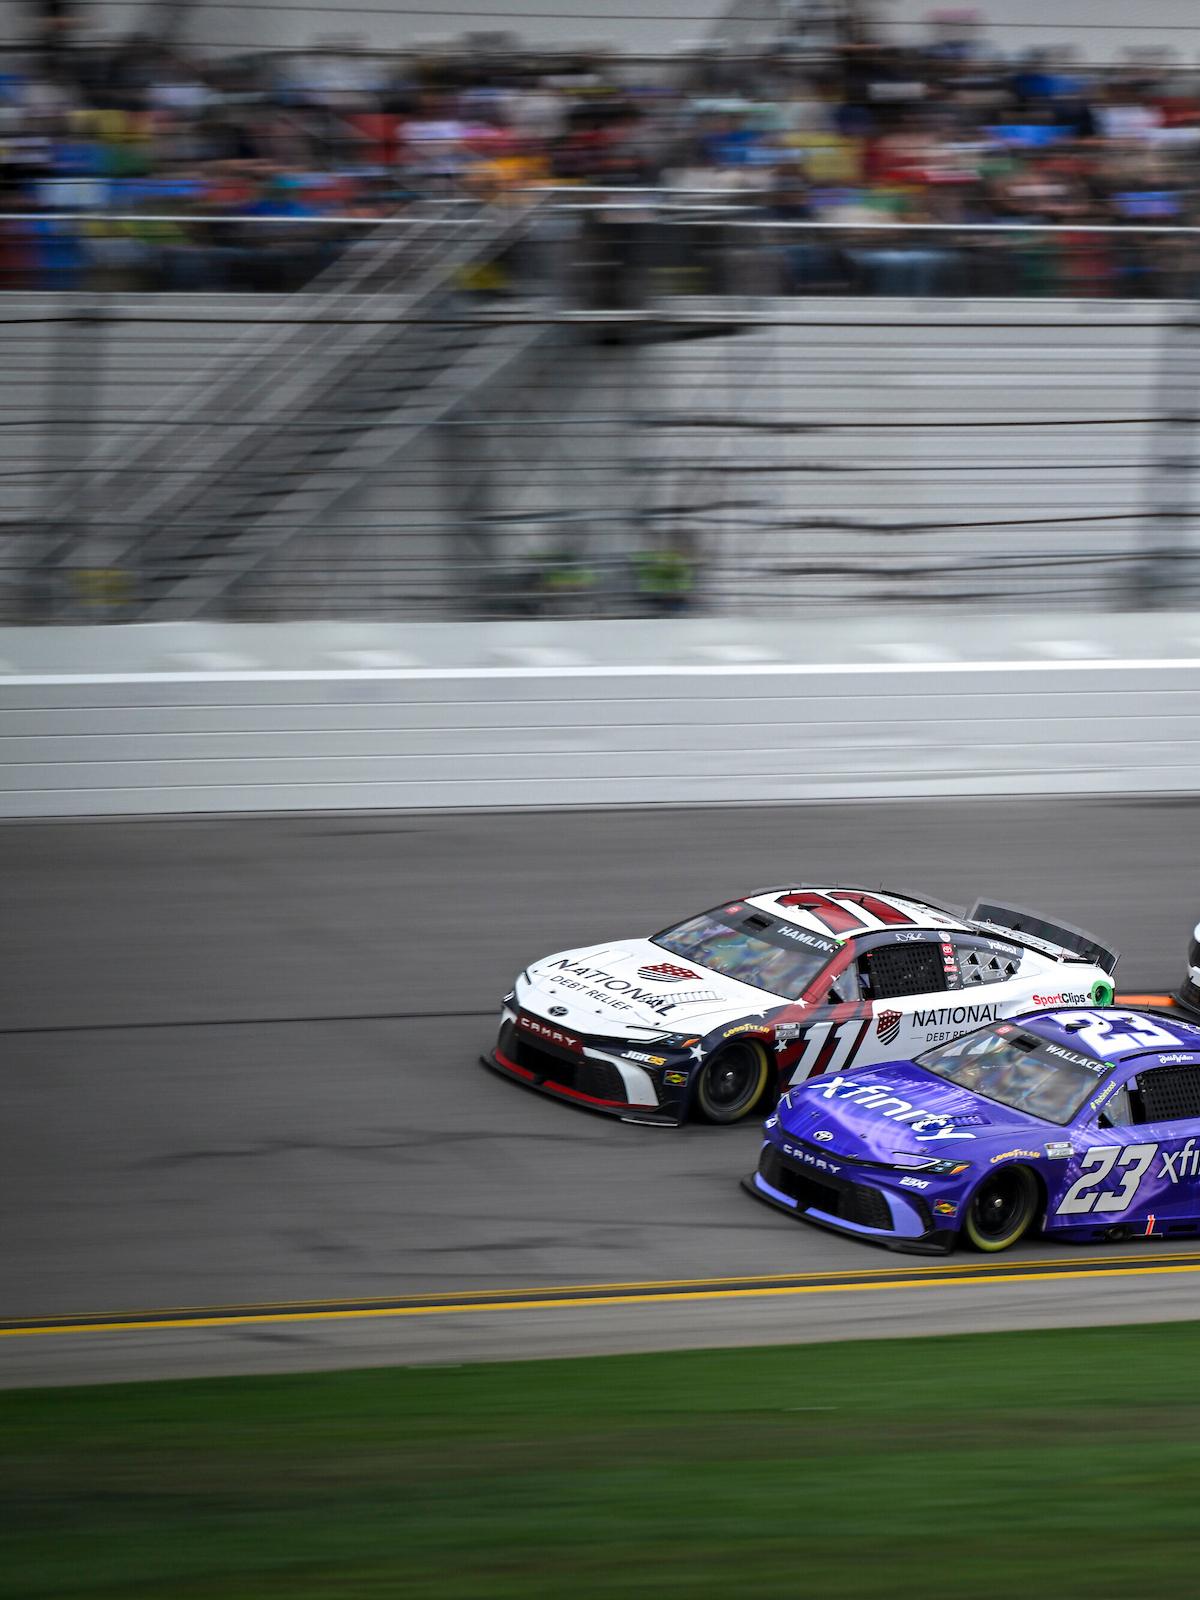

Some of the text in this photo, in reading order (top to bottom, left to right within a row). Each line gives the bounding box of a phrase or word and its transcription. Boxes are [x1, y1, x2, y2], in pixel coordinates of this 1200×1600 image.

[774, 892, 919, 935] 11
[778, 925, 833, 952] HAMLIN
[987, 940, 1017, 955] yahoo!
[547, 959, 677, 1017] NATIONAL
[550, 975, 633, 1011] DEBT RELIEF
[722, 1023, 770, 1039] GOODYEAR
[912, 1004, 1001, 1028] NATIONAL
[520, 1017, 577, 1046] CAMRY
[926, 1031, 951, 1042] DEBT
[1050, 1011, 1185, 1056] 23
[788, 1019, 865, 1086] 11
[1045, 1044, 1103, 1072] WALLACE
[808, 1076, 977, 1141] xfinity
[783, 1143, 841, 1174] CAMRY
[990, 1149, 1041, 1164] GOODYEAR
[1055, 1144, 1158, 1215] 23
